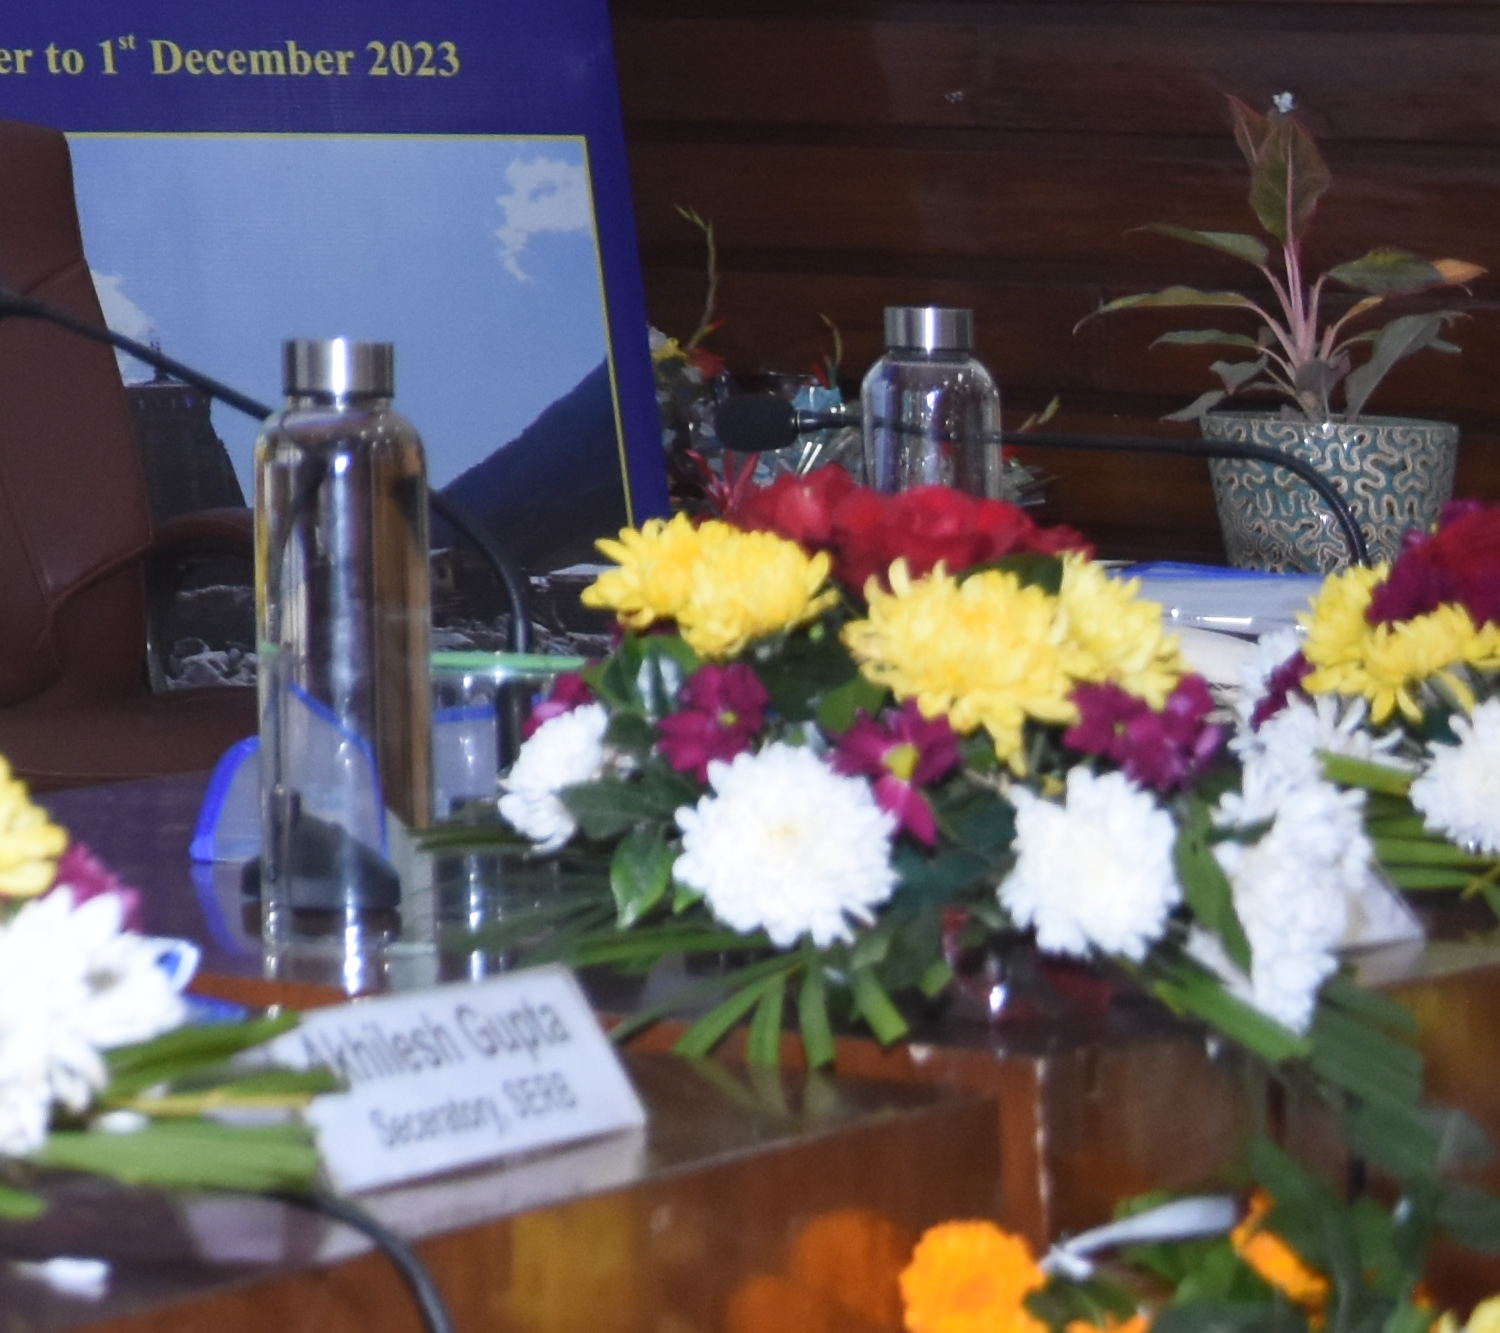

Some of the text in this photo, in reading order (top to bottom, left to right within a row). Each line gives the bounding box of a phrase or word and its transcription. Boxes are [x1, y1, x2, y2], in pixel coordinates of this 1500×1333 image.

[44, 42, 84, 75] to
[98, 35, 135, 76] 1st
[151, 40, 355, 77] December
[366, 41, 460, 78] 2023
[455, 997, 572, 1063] Gupta
[503, 1070, 577, 1119] SERB
